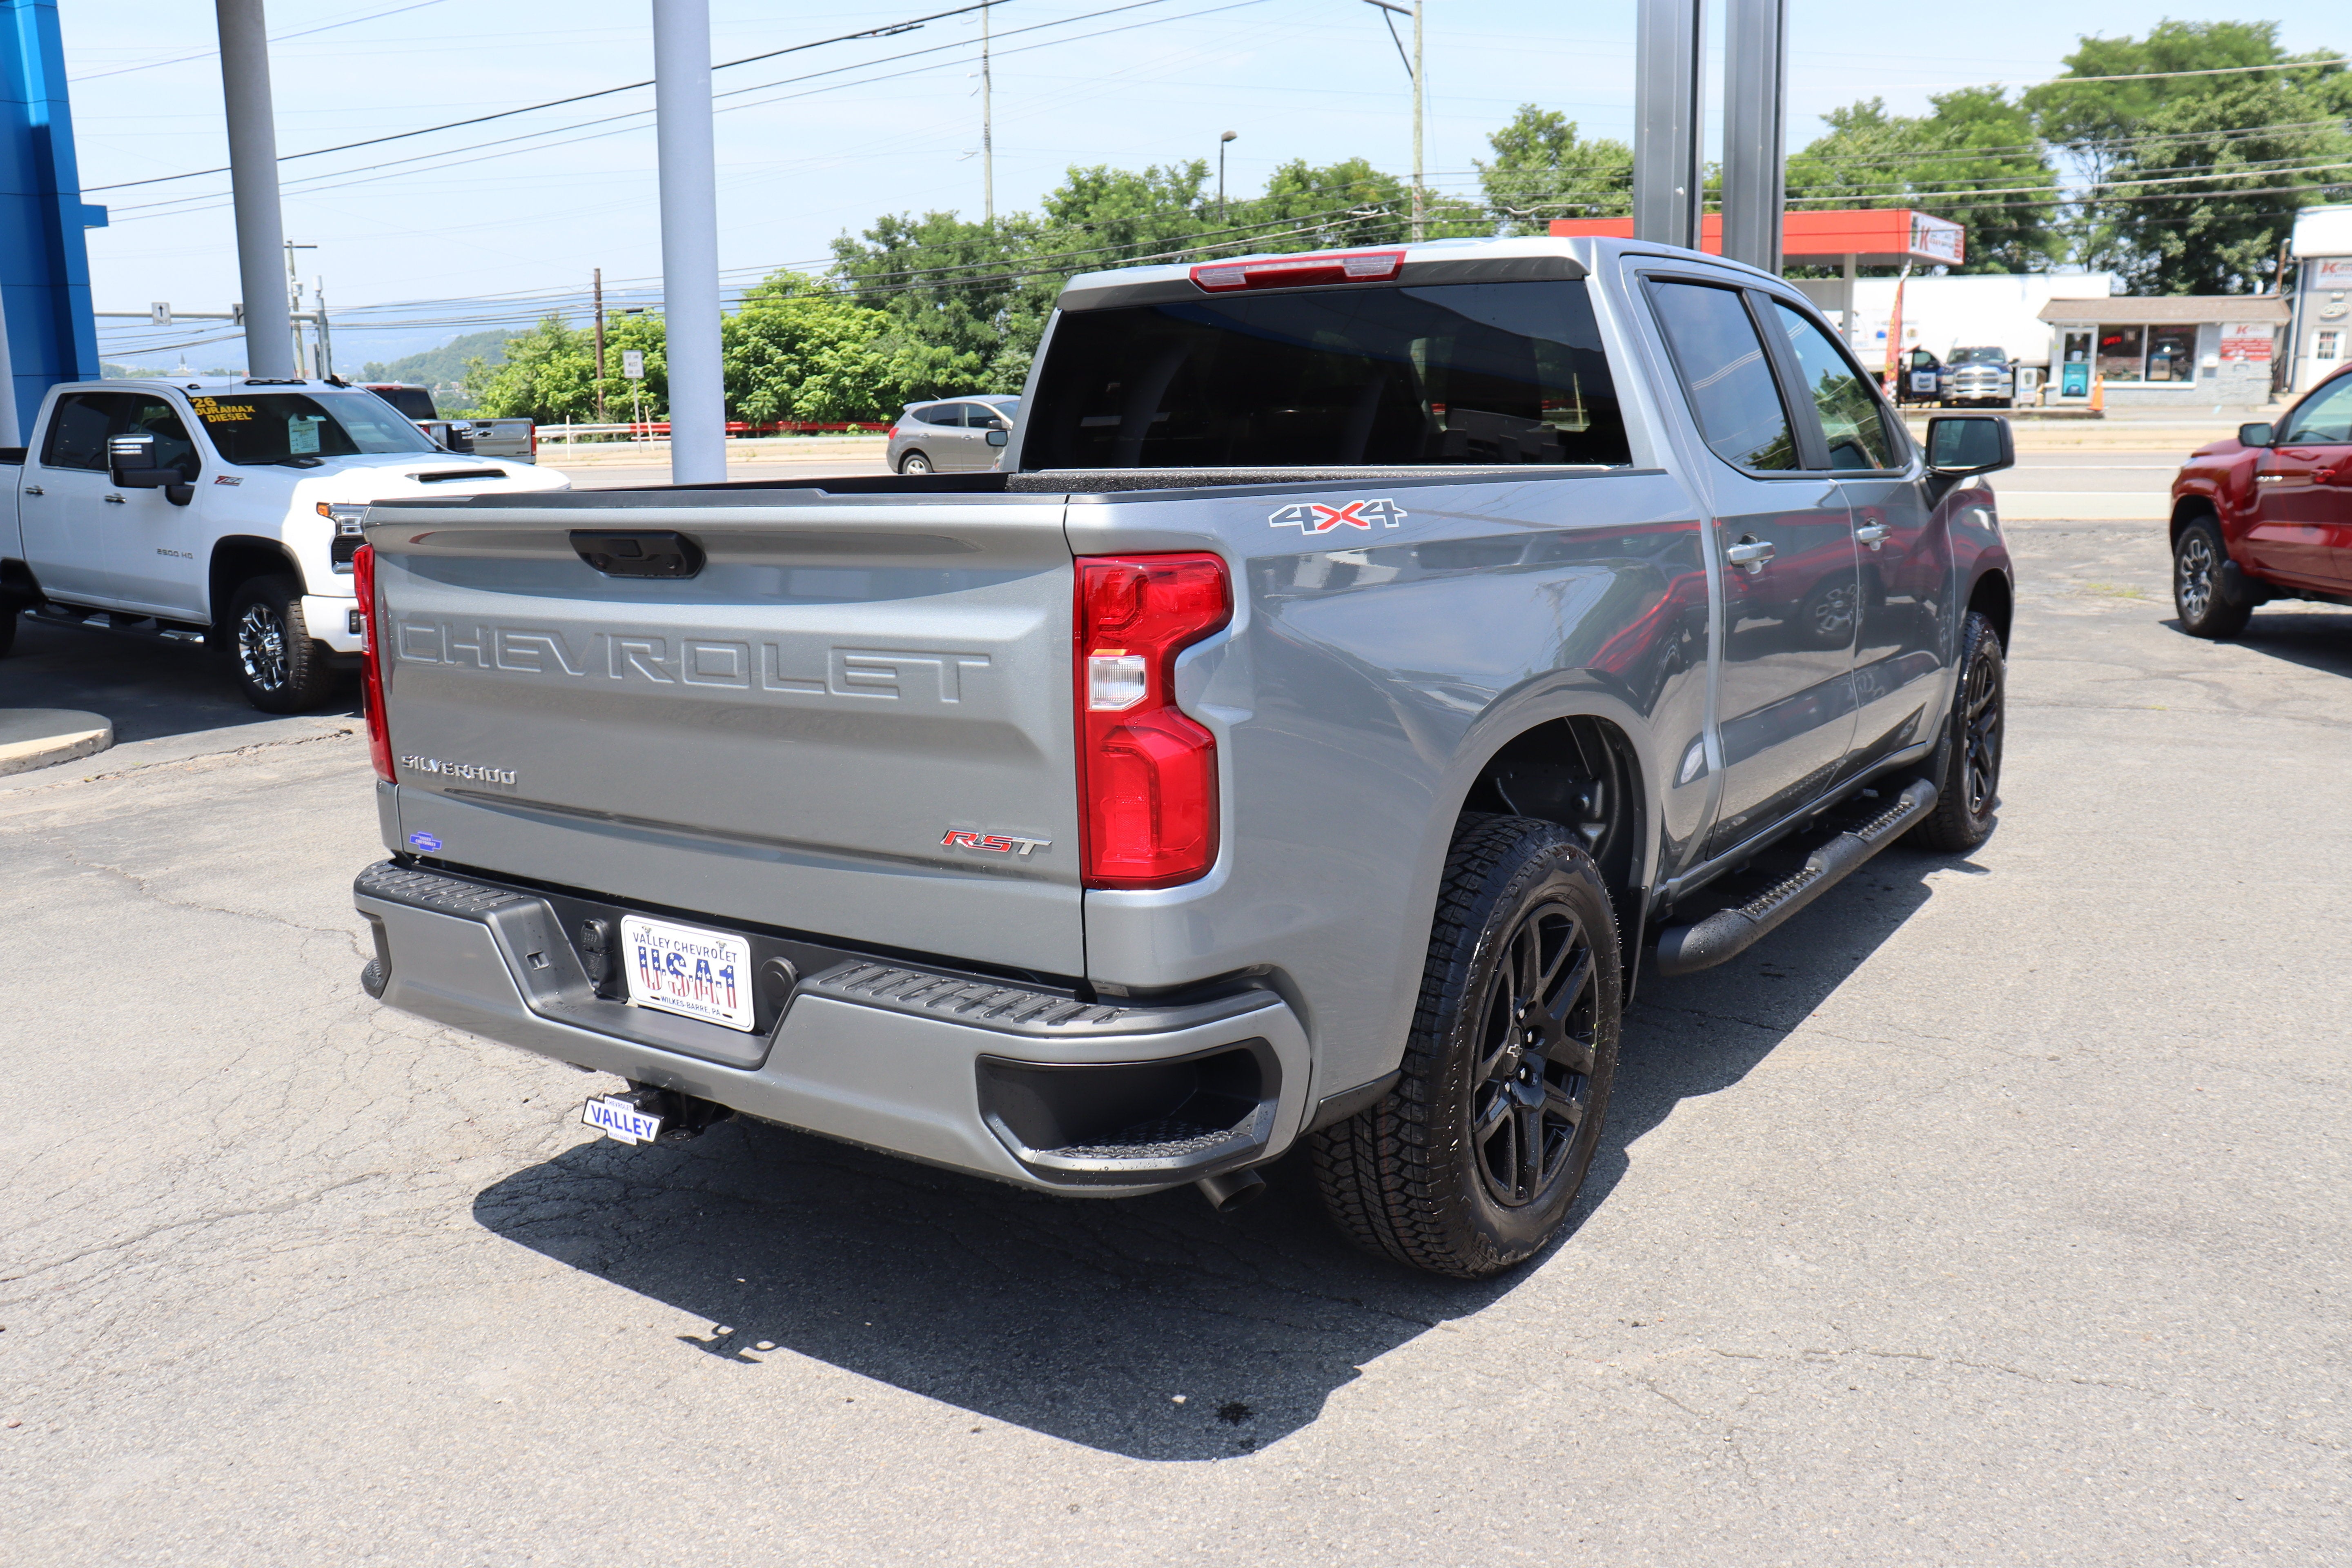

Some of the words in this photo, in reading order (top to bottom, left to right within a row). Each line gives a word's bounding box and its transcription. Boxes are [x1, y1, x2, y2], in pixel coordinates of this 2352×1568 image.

[194, 405, 256, 416] DURAMAX
[207, 412, 252, 423] DIESEL
[398, 619, 991, 703] CHEVROLET
[401, 755, 517, 785] SILVERADO
[940, 829, 1052, 855] RST
[633, 932, 670, 949] VALLEY
[674, 941, 737, 963] CHEVROLET
[606, 1099, 632, 1111] CHEVROLET
[591, 1105, 653, 1138] VALLEY
